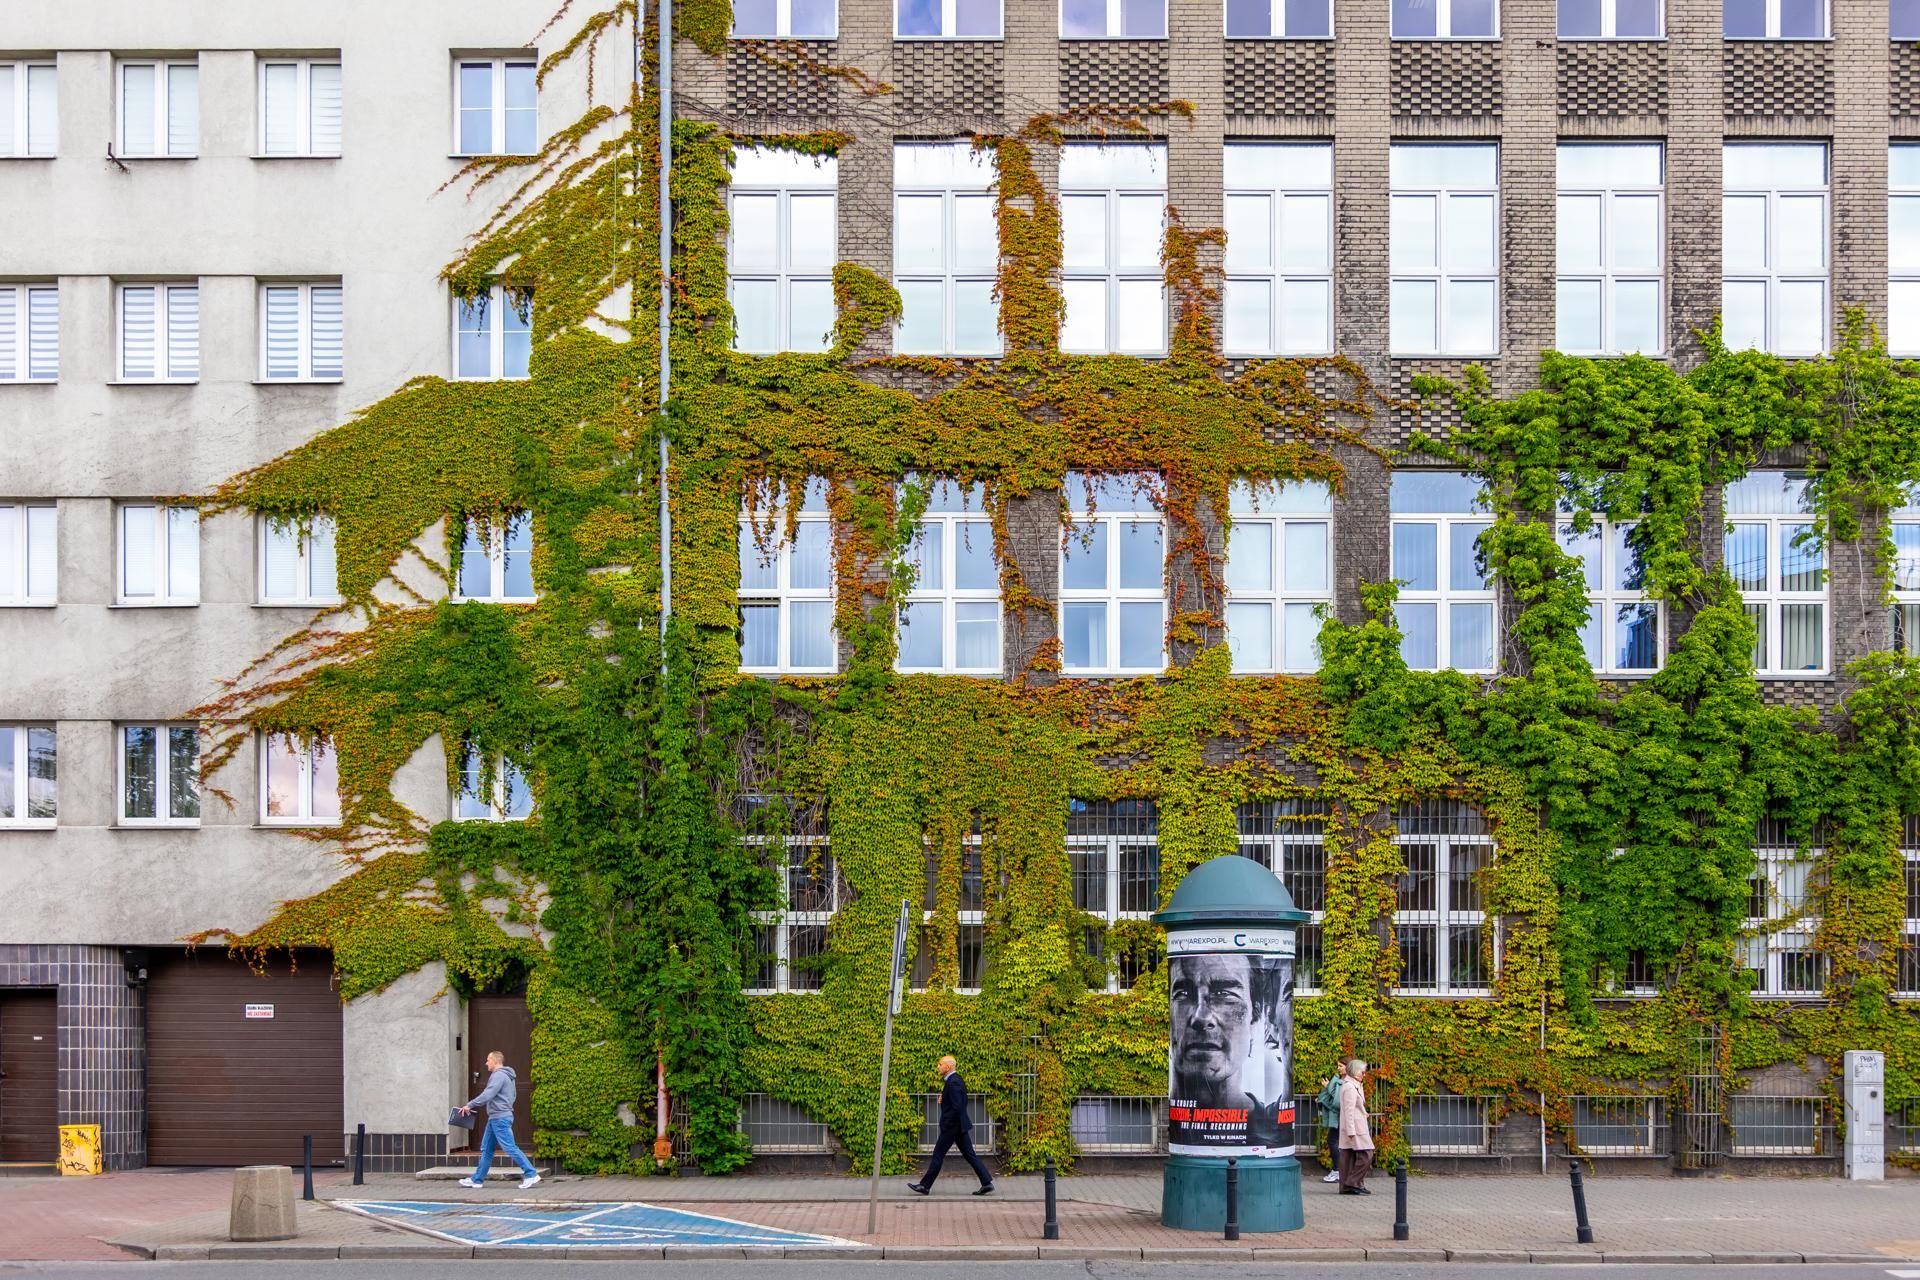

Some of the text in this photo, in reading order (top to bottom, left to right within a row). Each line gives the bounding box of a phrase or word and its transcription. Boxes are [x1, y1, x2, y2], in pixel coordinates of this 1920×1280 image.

[1170, 937, 1227, 945] WWWWAREXPO.PL
[1249, 937, 1279, 945] WAREXPO
[1176, 1100, 1197, 1108] CRUISE
[1193, 1109, 1249, 1122] IMPOSSIBLE
[1191, 1122, 1208, 1130] FINAL
[1210, 1122, 1248, 1130] RECKONING
